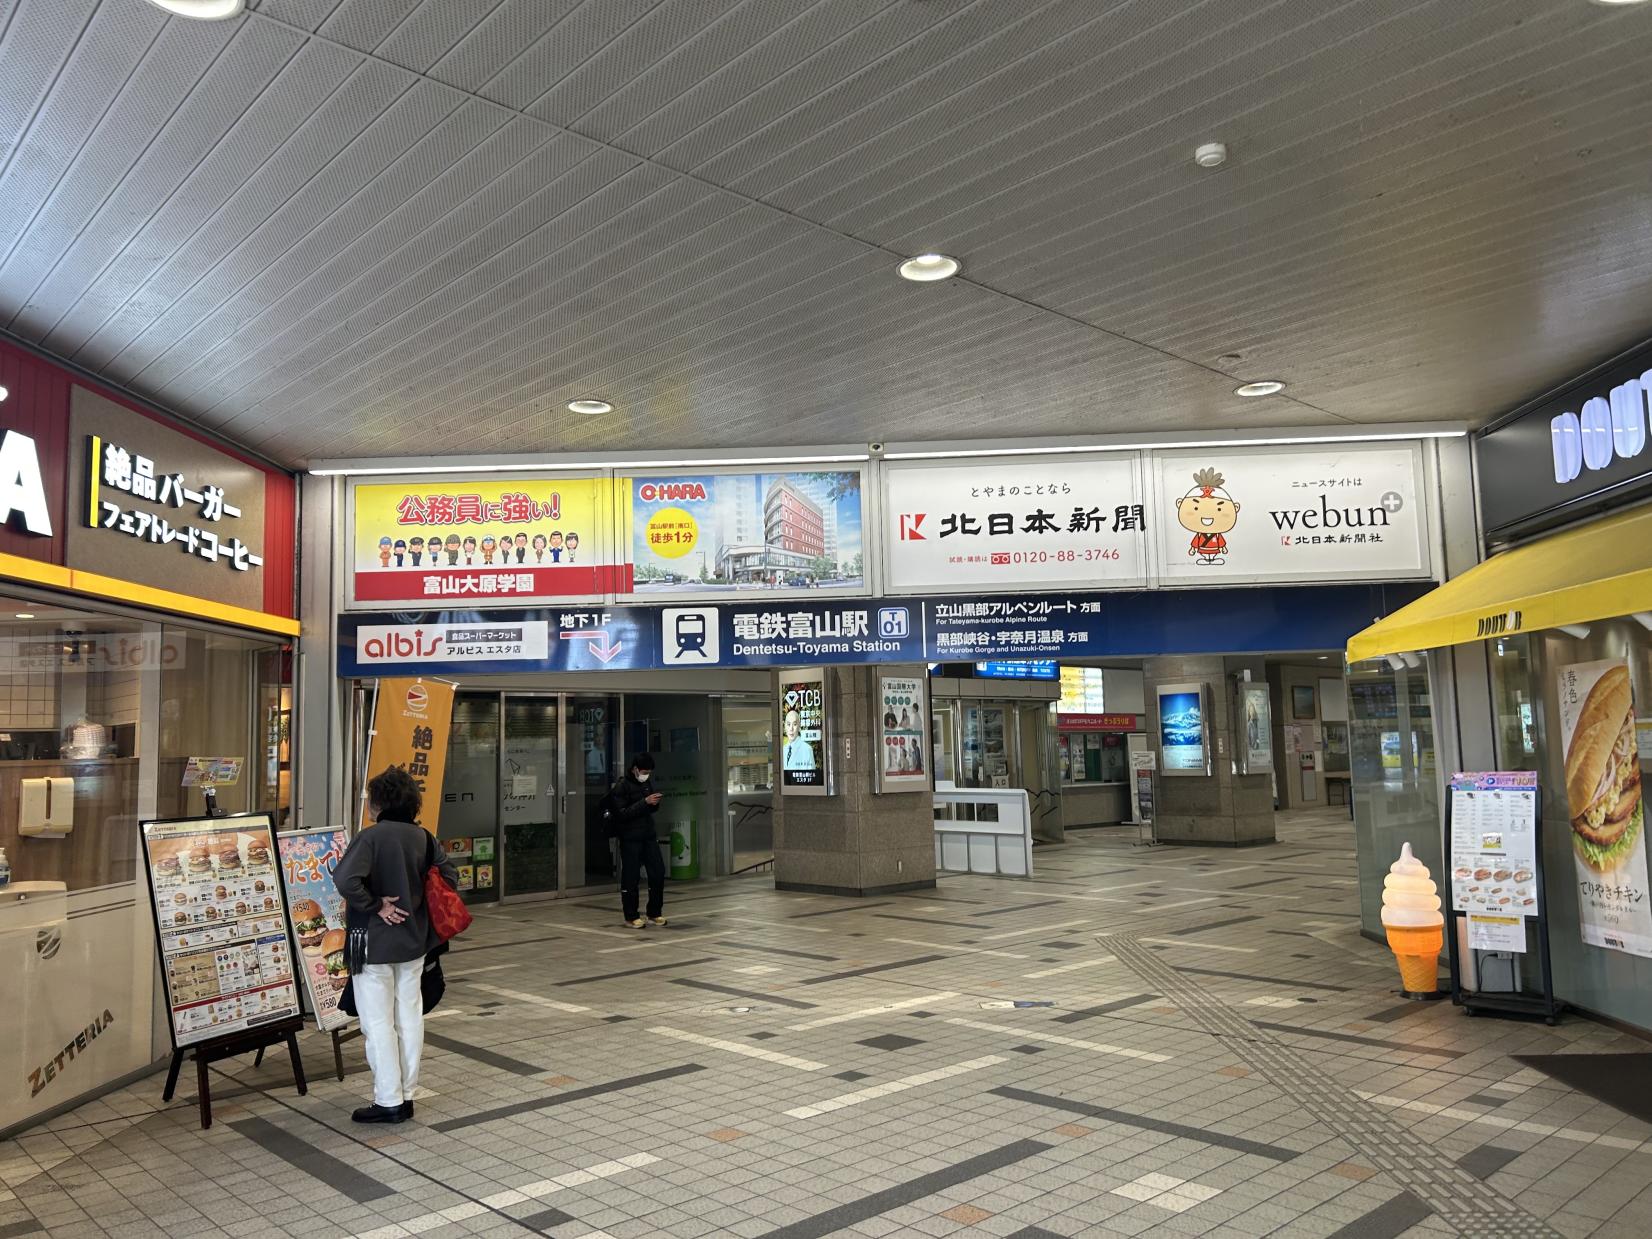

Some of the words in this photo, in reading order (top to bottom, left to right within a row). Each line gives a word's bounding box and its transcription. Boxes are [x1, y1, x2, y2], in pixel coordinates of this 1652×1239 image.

[104, 443, 242, 522] 絶品バーガー
[971, 482, 1072, 498] とやまのことなら
[1291, 478, 1363, 488] ニュースサイトは
[939, 504, 1147, 538] 北日本新聞
[102, 501, 264, 571] フェアトレードコーヒー
[651, 531, 694, 544] 徒歩1分
[1295, 533, 1383, 545] 北日本新聞社
[1013, 549, 1120, 564] 0120-88-3746
[423, 574, 535, 595] 富山大原学園
[888, 612, 898, 621] T
[936, 600, 1077, 617] 立山黒部アルペンルート
[1080, 602, 1101, 613] 方面
[560, 613, 612, 628] 地下1F
[733, 610, 869, 641] 電鉄富山駅
[883, 621, 903, 634] 01
[1005, 616, 1027, 625] Alpine
[364, 629, 443, 658] albis
[451, 632, 517, 641] 食品スーパーマーケット
[936, 630, 1064, 646] 黒部峡谷・宇奈月温泉
[1068, 632, 1088, 643] 方面
[446, 646, 484, 656] アルビス
[486, 645, 522, 654] エスタ店
[733, 641, 849, 656] Dentetsu-Toyama
[853, 640, 901, 652] Station
[975, 646, 995, 655] Gorge
[799, 689, 821, 707] TCB
[1580, 881, 1643, 904] てりやきチキン
[27, 1008, 114, 1099] ZETTERIA
